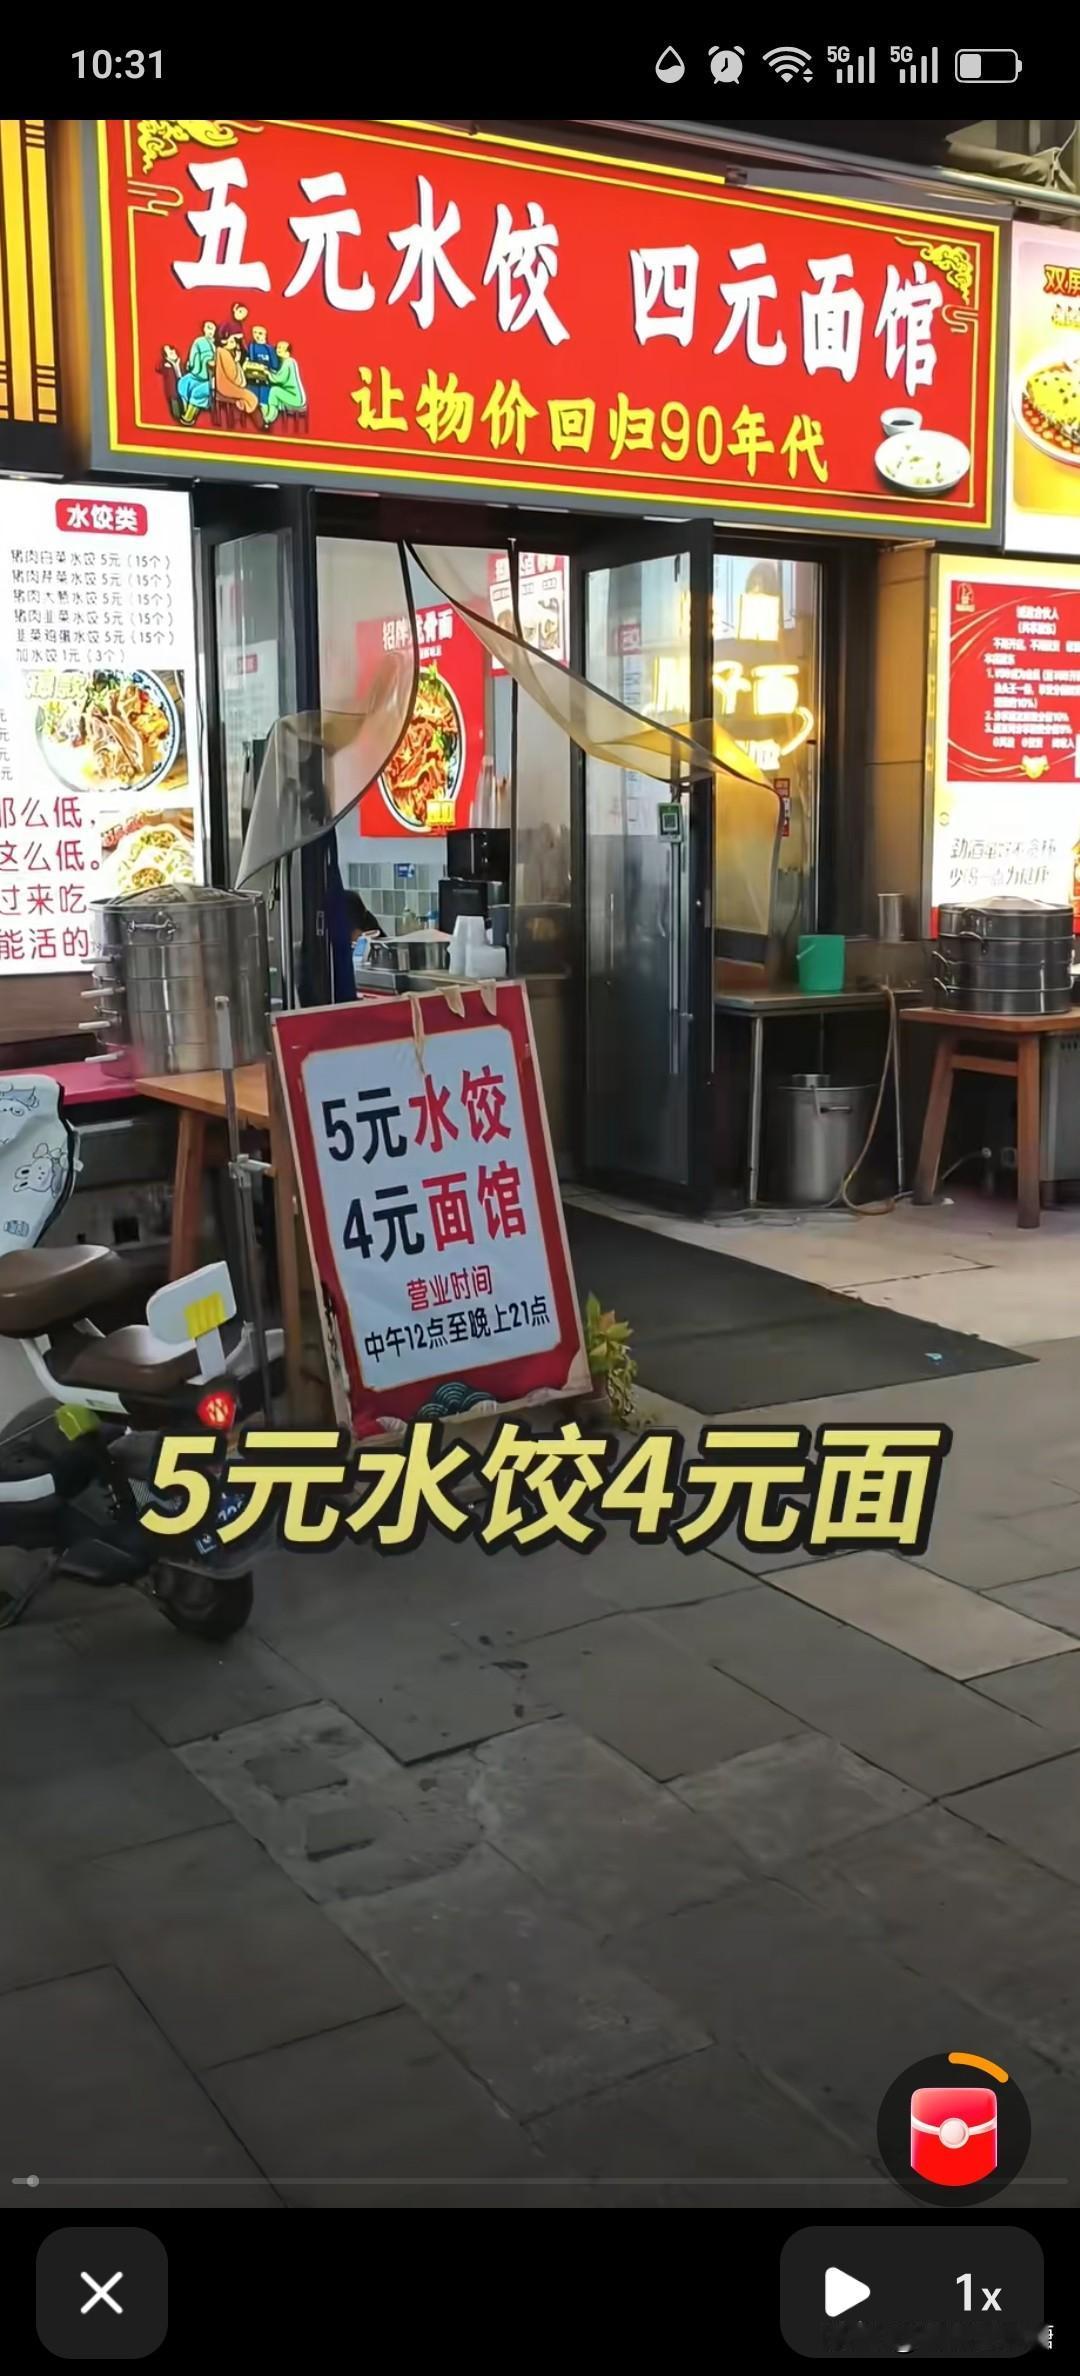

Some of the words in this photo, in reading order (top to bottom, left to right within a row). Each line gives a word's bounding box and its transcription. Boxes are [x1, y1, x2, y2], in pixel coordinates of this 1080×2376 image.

[71, 50, 165, 80] 10:31
[827, 45, 850, 64] 5G
[890, 45, 914, 64] 5G
[171, 156, 571, 346] 五元水饺
[628, 242, 944, 397] 四元面馆
[350, 365, 830, 483] 让物价回归90年代
[66, 502, 139, 532] 水饺类
[0, 884, 88, 916] 过来吃
[0, 927, 90, 960] 能活的
[321, 1064, 512, 1165] 5元水饺
[342, 1160, 527, 1263] 4元面馆
[406, 1265, 493, 1312] 营业时间
[364, 1295, 551, 1364] 中午12点至晚上21点
[956, 2273, 1002, 2311] 1x
